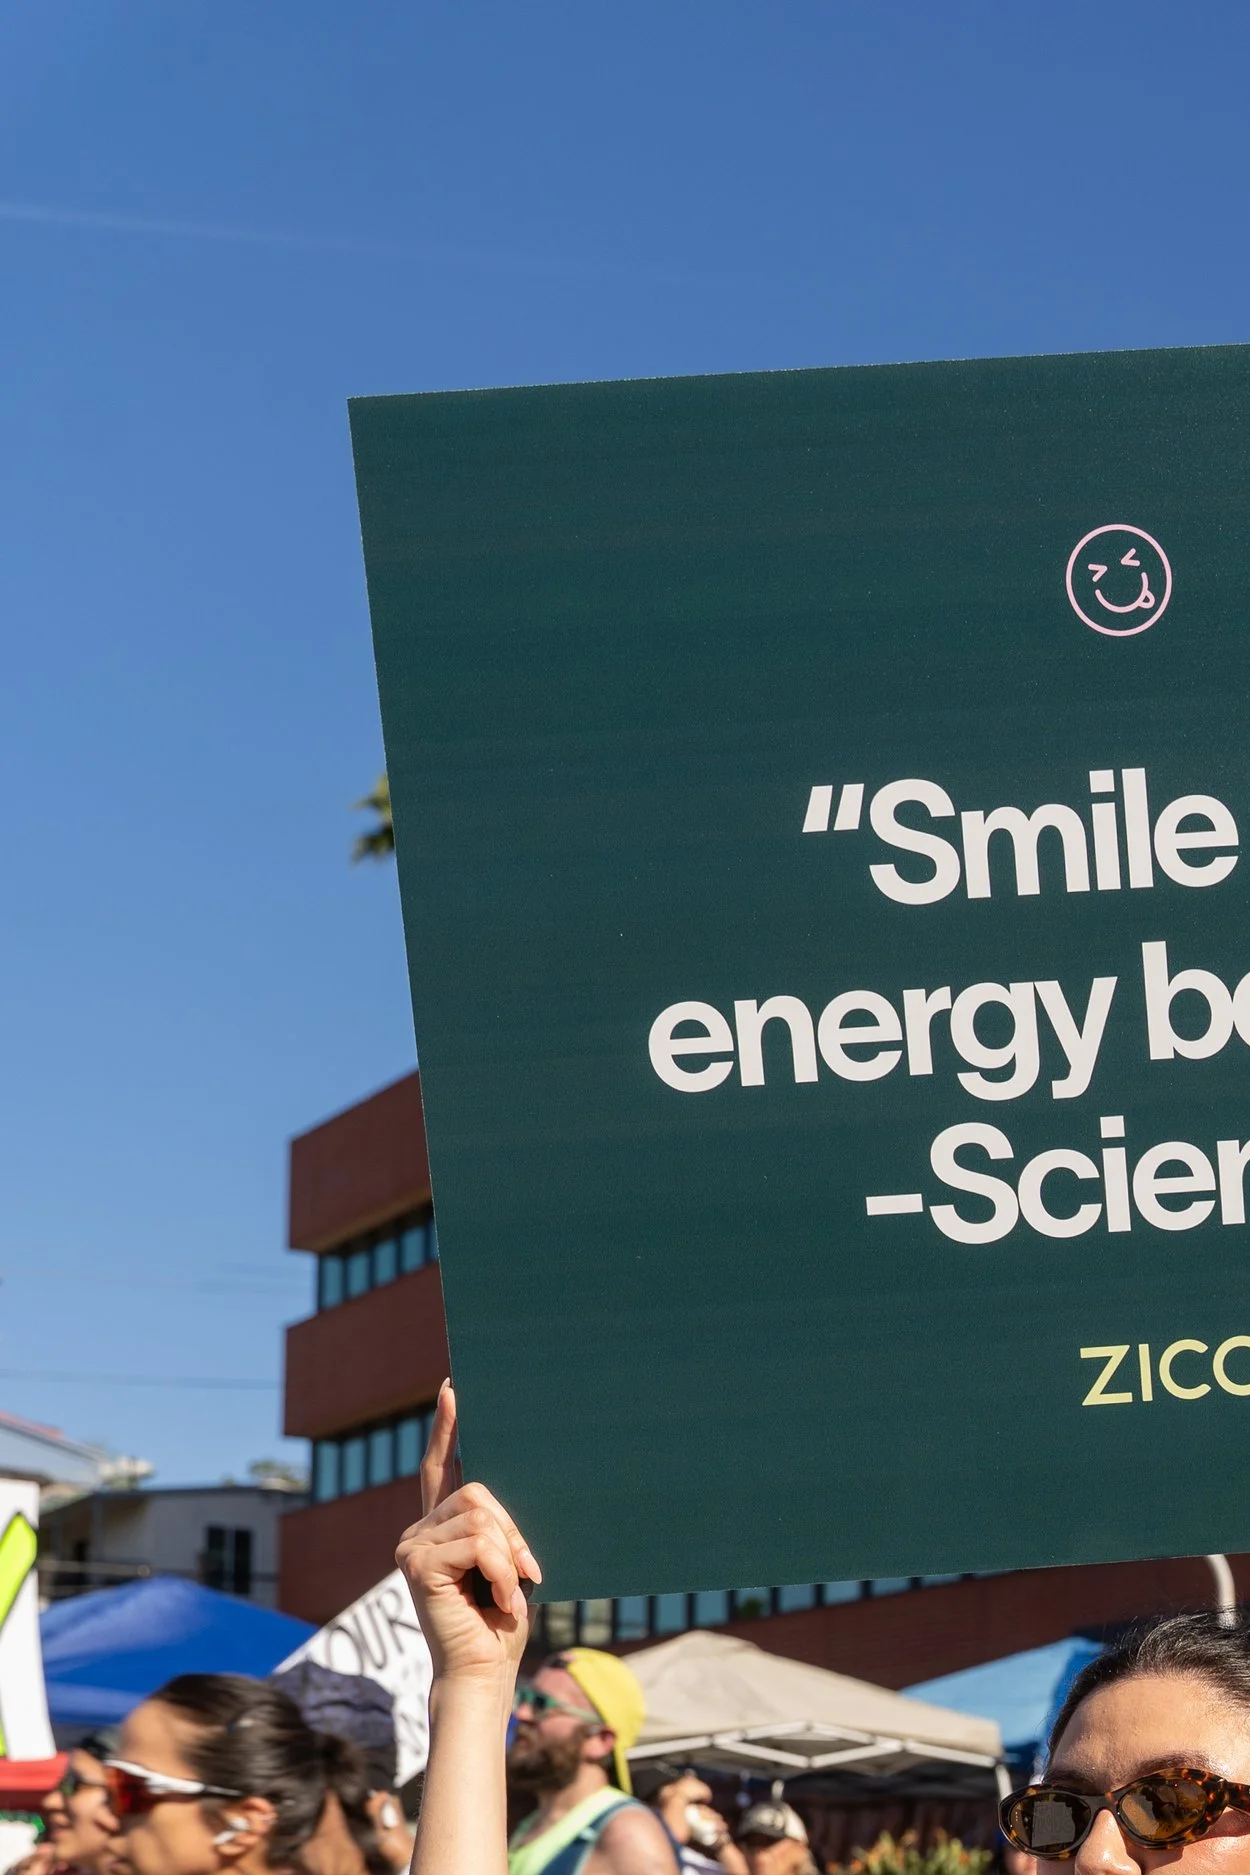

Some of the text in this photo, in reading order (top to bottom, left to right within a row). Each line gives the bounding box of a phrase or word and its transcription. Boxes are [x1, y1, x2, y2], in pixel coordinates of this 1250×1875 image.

[803, 767, 1239, 905] "Smile
[648, 976, 1118, 1101] energy
[316, 1587, 422, 1677] OUR
